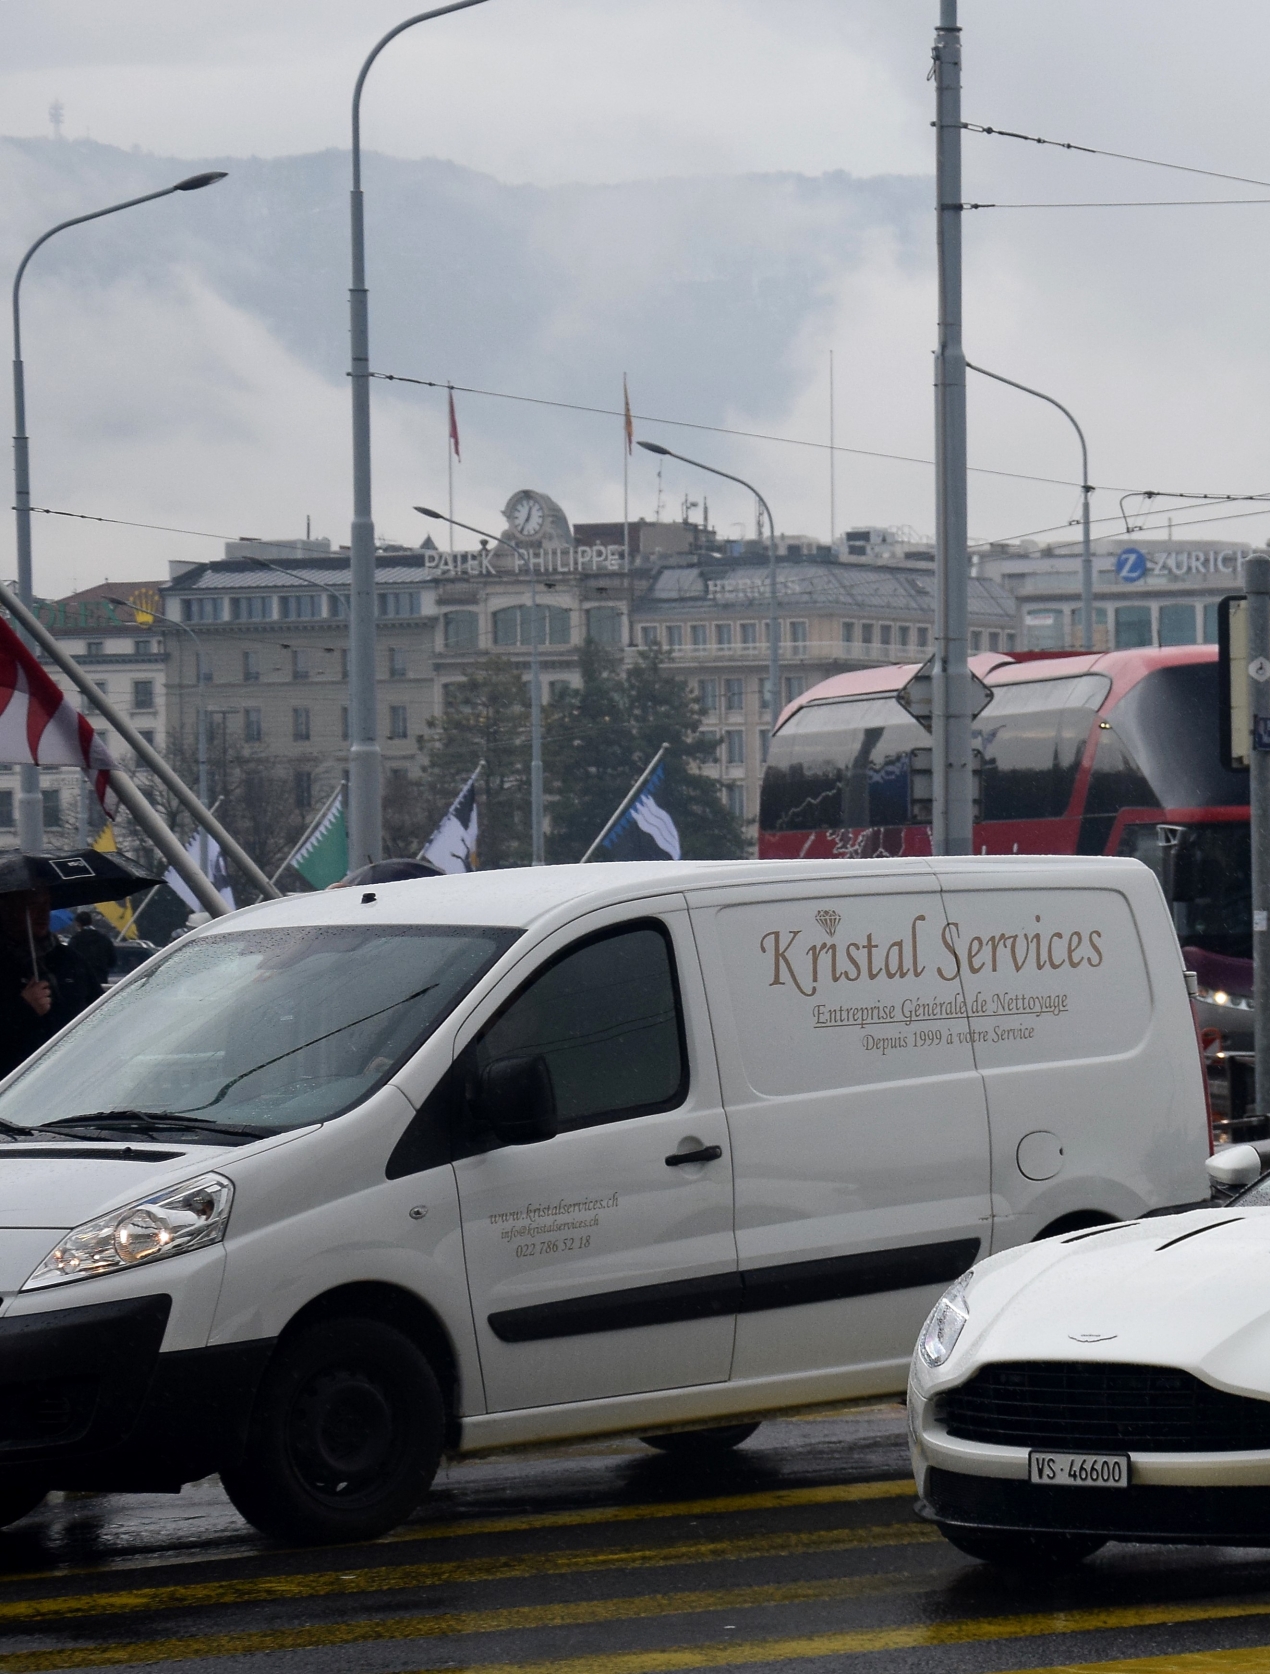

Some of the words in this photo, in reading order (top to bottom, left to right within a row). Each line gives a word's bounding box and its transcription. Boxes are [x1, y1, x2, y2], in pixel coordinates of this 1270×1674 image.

[424, 550, 497, 575] PATEK
[514, 545, 620, 573] PHILIPPE
[1153, 549, 1255, 575] ZURICH
[759, 914, 927, 997] Kristal
[936, 914, 1104, 982] Services
[812, 1003, 896, 1028] Entreprise
[901, 992, 967, 1026] Générale
[970, 991, 990, 1014] de
[991, 992, 1069, 1017] Nettoyage
[861, 1032, 909, 1055] Depuis
[911, 1029, 943, 1048] 1999
[945, 1028, 955, 1046] à
[957, 1029, 989, 1045] votre
[991, 1023, 1035, 1044] Service
[488, 1191, 619, 1225] www.kristalservices.ch
[500, 1213, 600, 1243] info@kristalservices.ch
[515, 1242, 536, 1258] 022
[539, 1239, 559, 1255] 786
[561, 1237, 575, 1252] 52
[577, 1234, 592, 1250] 18
